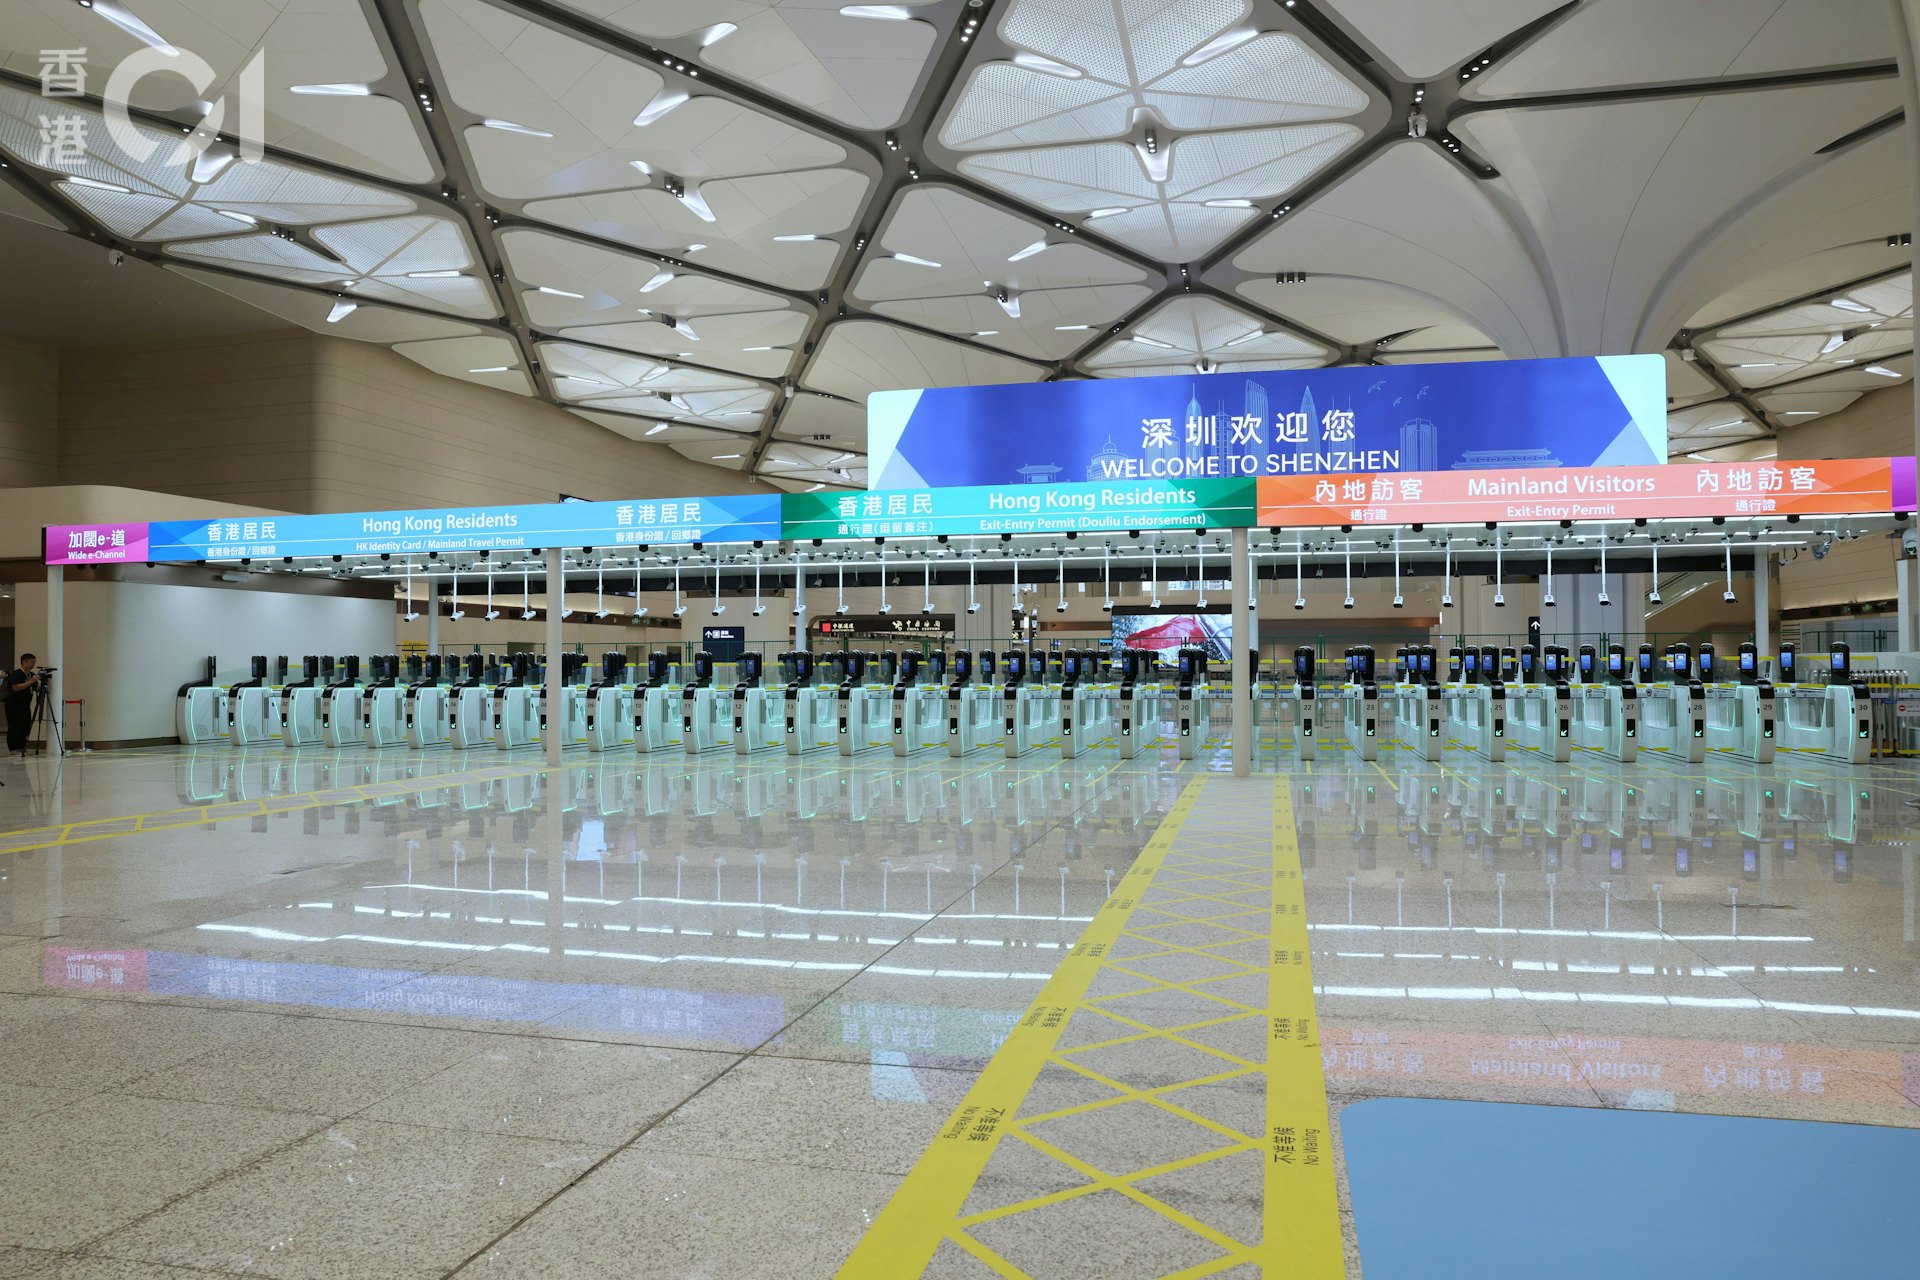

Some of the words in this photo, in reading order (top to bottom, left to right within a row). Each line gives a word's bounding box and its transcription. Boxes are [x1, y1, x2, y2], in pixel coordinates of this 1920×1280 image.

[1141, 410, 1355, 449] 深圳欢迎您
[1101, 456, 1220, 478] WELCOME
[1226, 454, 1258, 474] TO
[1266, 450, 1400, 473] SHENZHEN
[1468, 476, 1568, 497] Mainland
[1574, 475, 1656, 494] Visitors
[838, 494, 932, 517] 香港居民
[990, 493, 1040, 512] Hong
[1046, 491, 1096, 510] Kong
[1102, 488, 1196, 506] Residents
[1507, 505, 1569, 518] Exit-Entry
[1572, 504, 1616, 516] Permit
[1736, 499, 1776, 512] 通行證
[363, 518, 400, 535] Hong
[405, 516, 442, 533] Kong
[446, 512, 517, 529] Residents
[616, 502, 702, 526] 香港居民
[980, 517, 1035, 531] Exit-Entry
[1037, 516, 1076, 528] Permit
[1078, 515, 1121, 528] (Douliu
[1124, 513, 1206, 527] Endorsement)
[1350, 509, 1388, 522] 通行證
[208, 522, 276, 542] 香港居民
[68, 551, 86, 560] Wide
[88, 549, 126, 559] e-Channel
[356, 542, 368, 551] HK
[369, 540, 400, 552] Identity
[402, 540, 421, 550] Card
[428, 538, 467, 549] Mainland
[468, 537, 494, 547] Travel
[496, 536, 524, 546] Permit
[1272, 1126, 1296, 1164] 不准等候
[1302, 1128, 1320, 1153] Waiting
[1304, 1155, 1319, 1166] No
